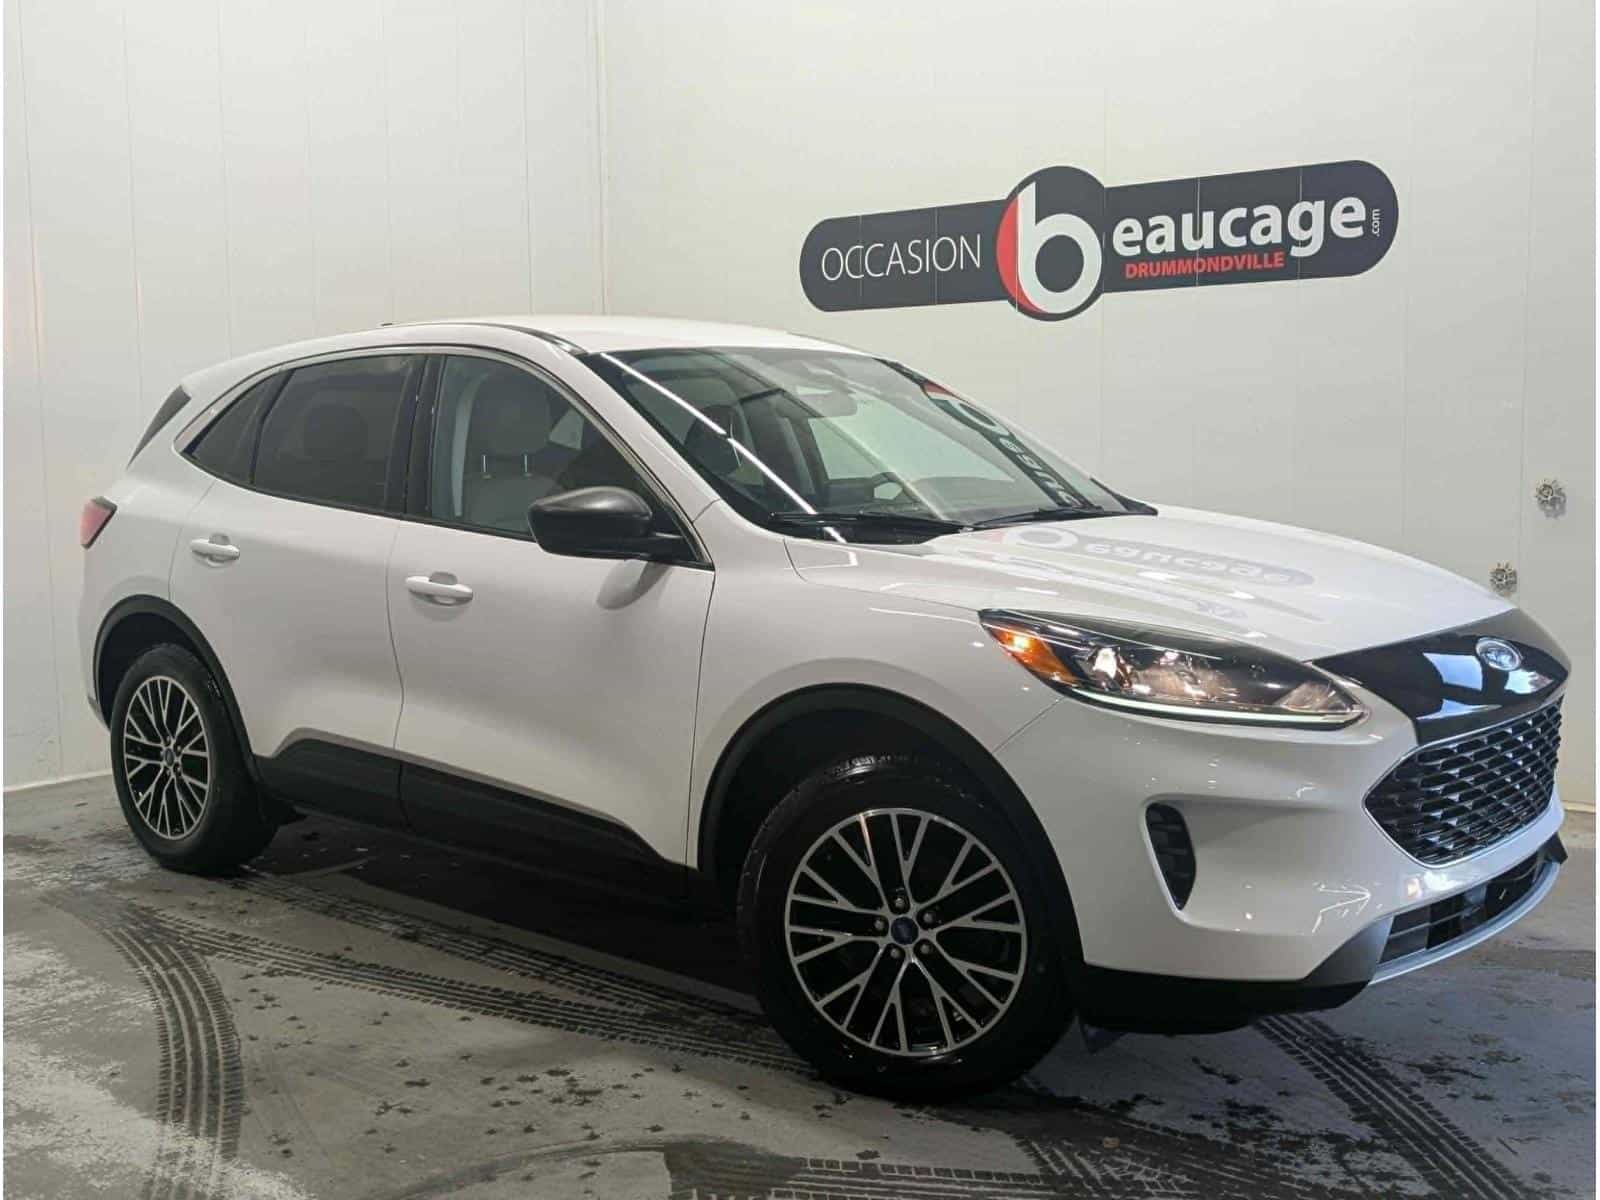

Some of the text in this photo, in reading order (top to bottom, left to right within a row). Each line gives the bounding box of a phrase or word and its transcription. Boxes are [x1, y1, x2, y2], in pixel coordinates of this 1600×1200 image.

[821, 233, 981, 281] OCCASION
[1371, 208, 1381, 237] .com
[1124, 251, 1286, 279] DRUMMONDVILLE
